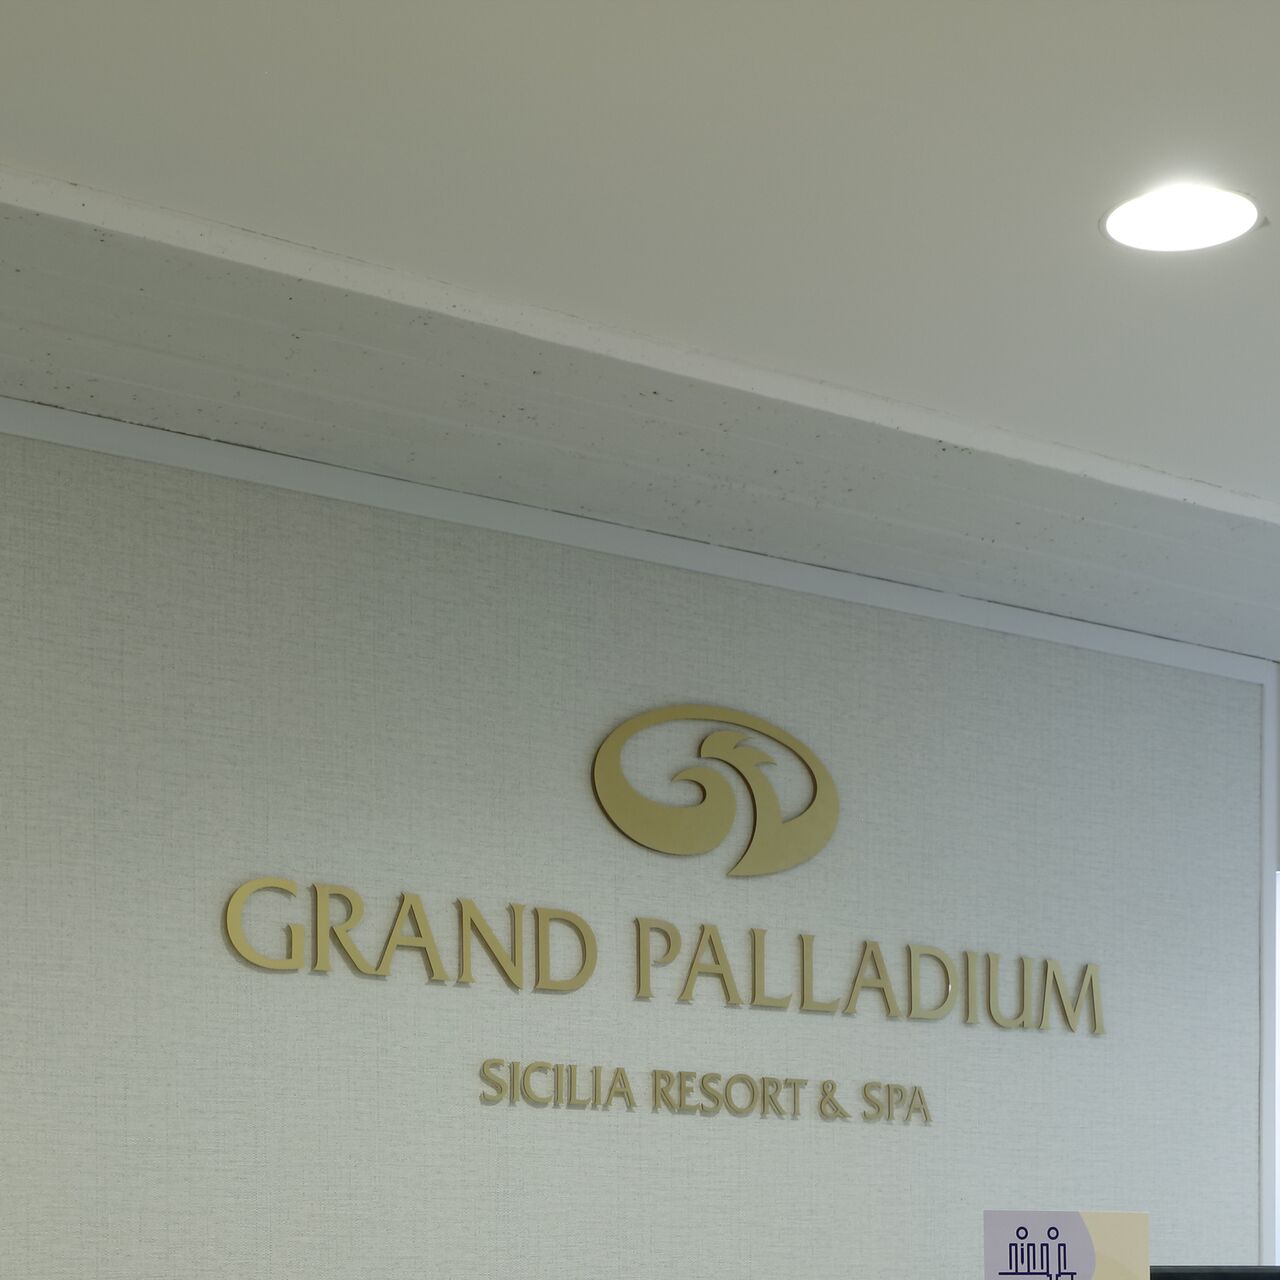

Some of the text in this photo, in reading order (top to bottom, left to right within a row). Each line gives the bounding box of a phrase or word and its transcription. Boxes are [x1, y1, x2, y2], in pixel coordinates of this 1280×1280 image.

[225, 877, 1106, 1036] GRAND PALLADIUM
[479, 1058, 933, 1124] SICILIA RESORT & SPA
